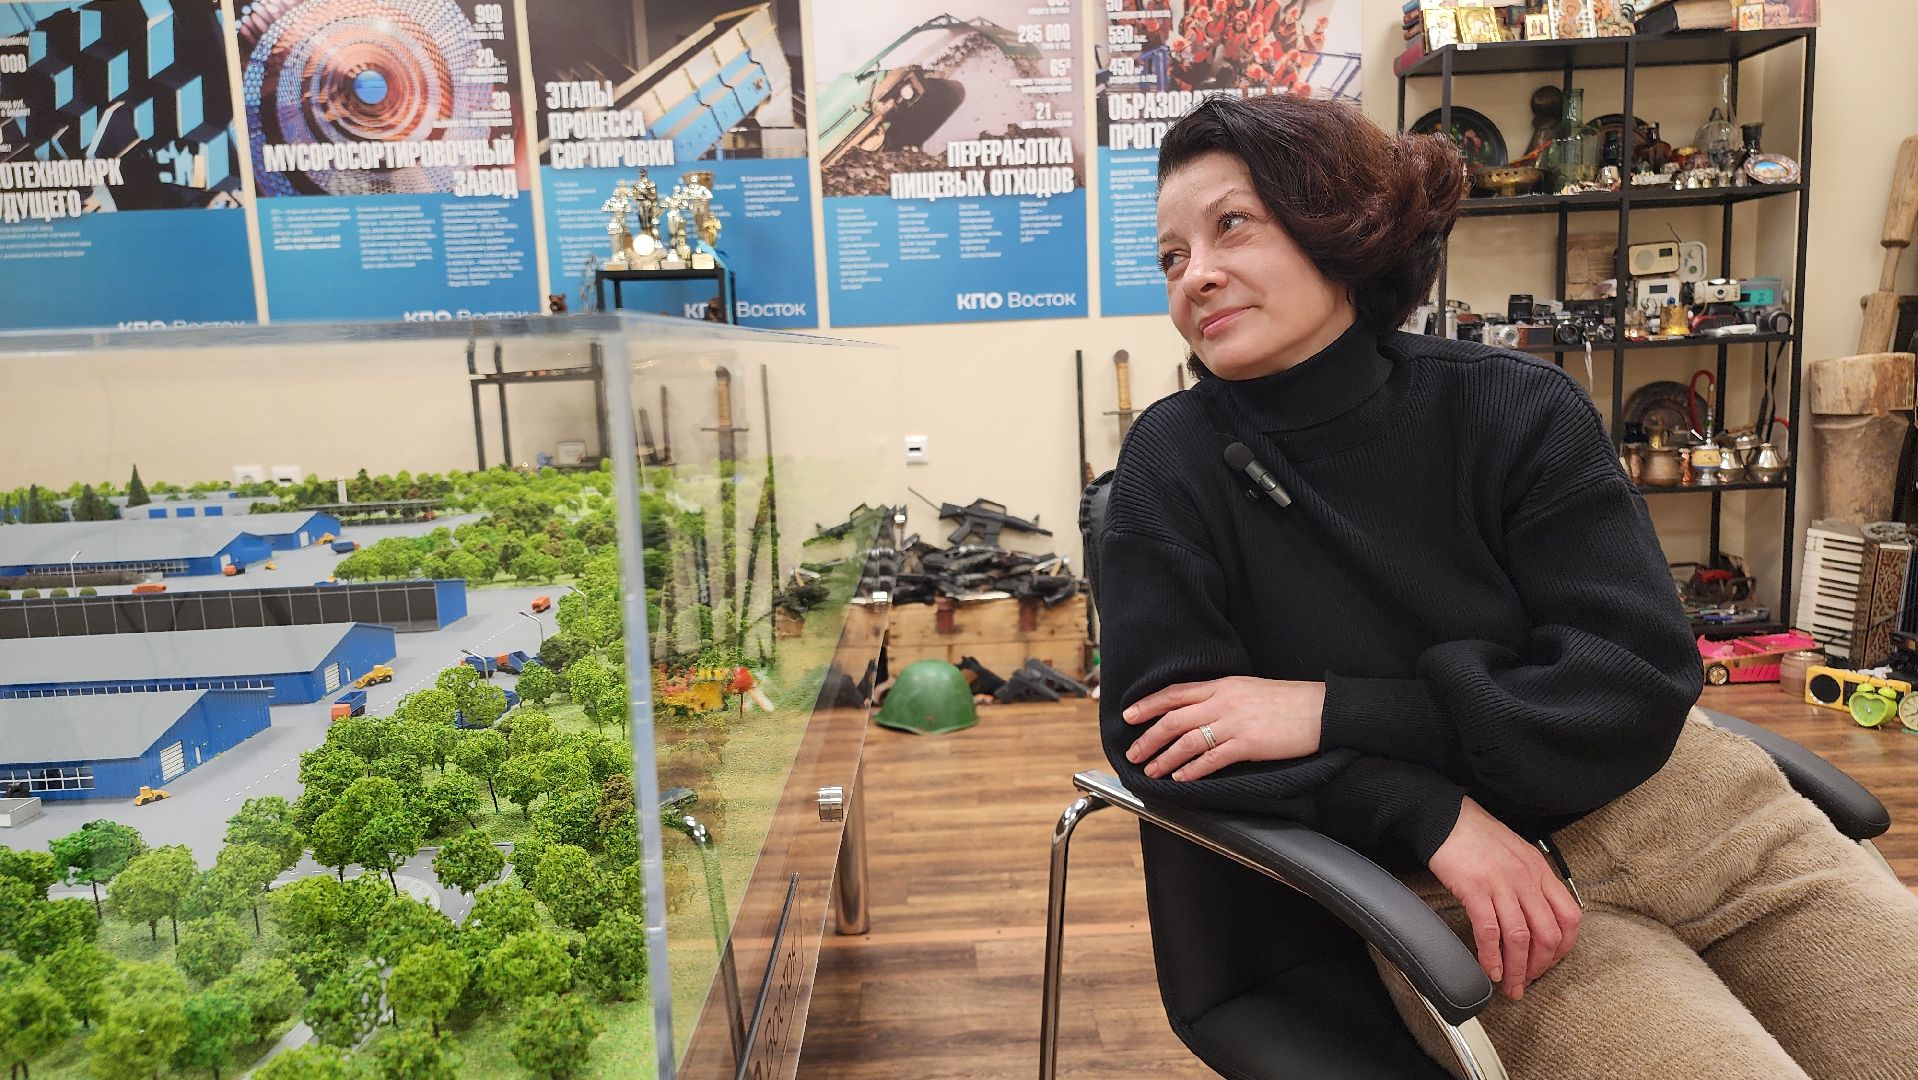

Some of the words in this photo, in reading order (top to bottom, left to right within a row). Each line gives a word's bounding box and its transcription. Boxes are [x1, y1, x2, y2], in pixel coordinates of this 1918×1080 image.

[1045, 23, 1070, 42] 000
[1108, 25, 1133, 44] 550
[1108, 57, 1135, 76] 450
[545, 80, 614, 109] ЭТАПЫ
[547, 110, 646, 140] ПРОЦЕССА
[1035, 102, 1052, 120] 21
[263, 133, 515, 173] МУСОРОСОРТИРОВОЧНЫЙ
[550, 139, 675, 169] СОРТИРОВКИ
[947, 137, 1073, 167] ПЕРЕРАБОТКА
[453, 168, 519, 199] ЗАВОД
[890, 170, 986, 201] ПИЩЕВЫХ
[990, 167, 1074, 198] ОТХОДОВ
[957, 293, 1003, 310] КПО
